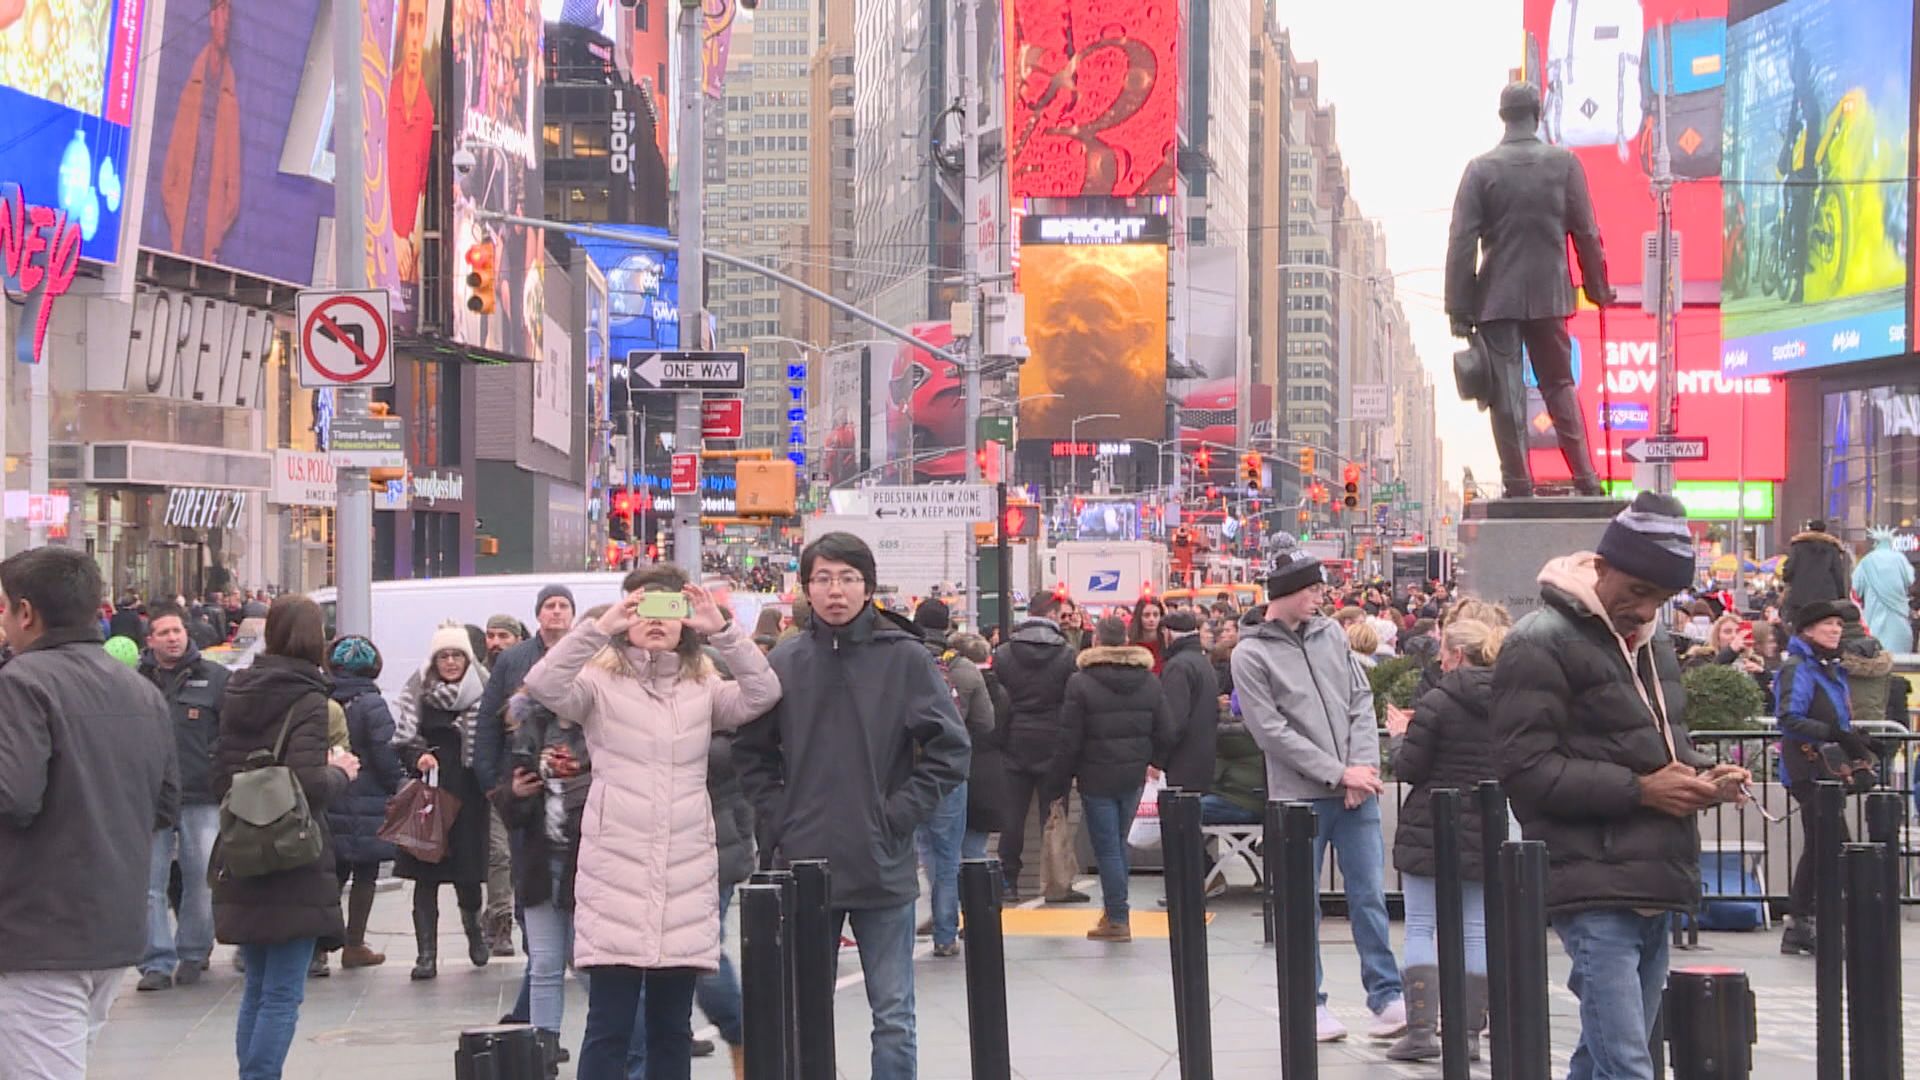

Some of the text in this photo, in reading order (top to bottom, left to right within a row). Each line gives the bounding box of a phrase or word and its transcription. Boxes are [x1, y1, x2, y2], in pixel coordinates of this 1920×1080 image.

[611, 90, 627, 173] 1500
[123, 284, 274, 409] FOREVER
[664, 364, 732, 377] ONE WAY
[1597, 369, 1772, 394] ADVNTURE
[333, 430, 392, 442] Times Square
[1647, 444, 1699, 455] ONE WAY
[287, 455, 333, 483] U.S. POLO
[873, 491, 979, 503] PEDESTRIAN FLOW ZONE
[163, 488, 246, 528] FOREVER 21
[922, 506, 981, 517] KEEP MOVING
